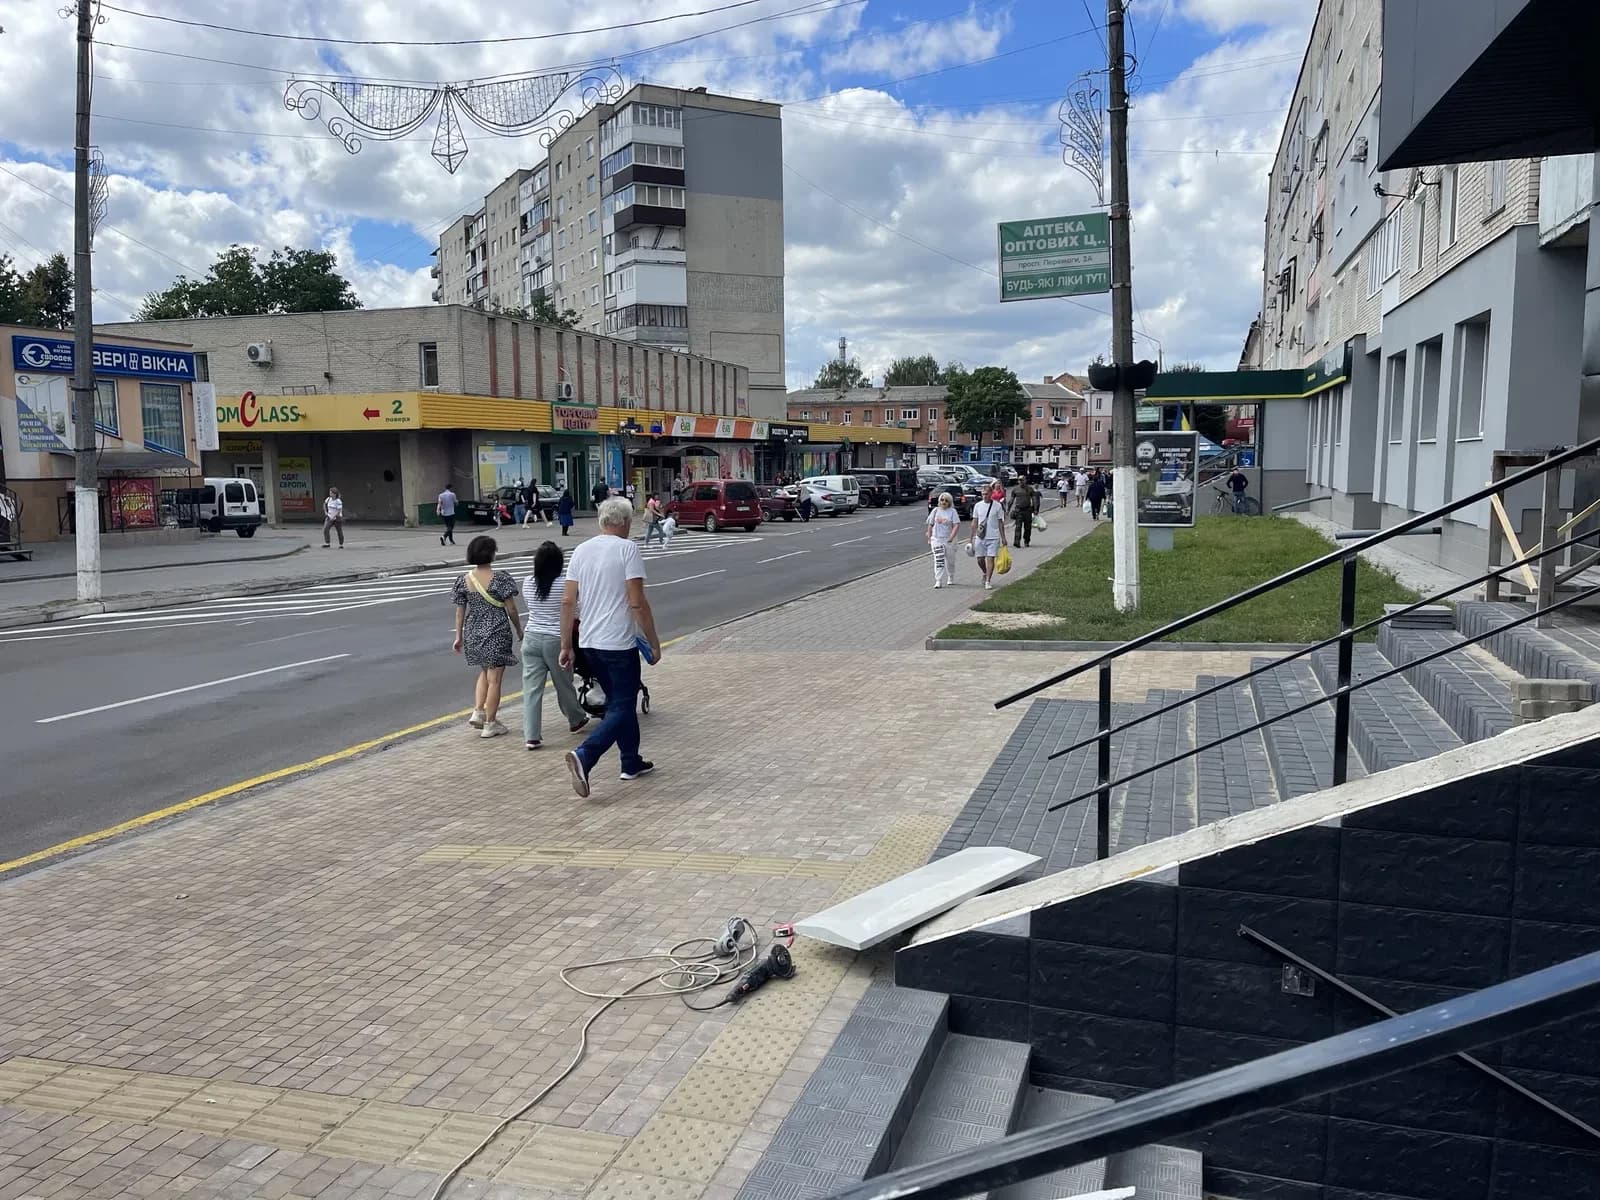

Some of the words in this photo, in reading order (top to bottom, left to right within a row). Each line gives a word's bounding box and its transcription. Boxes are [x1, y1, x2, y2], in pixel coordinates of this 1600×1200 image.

[1024, 221, 1086, 237] АПТЕКА
[1005, 235, 1079, 253] ОПТОВИХ
[1006, 278, 1054, 291] БУДЬ-ЯКІ
[1057, 275, 1082, 287] ЛІКИ
[92, 351, 127, 368] ВЕРІ
[141, 355, 189, 373] ВІКНА
[216, 391, 299, 427] OMCLASS
[392, 400, 403, 414] 2
